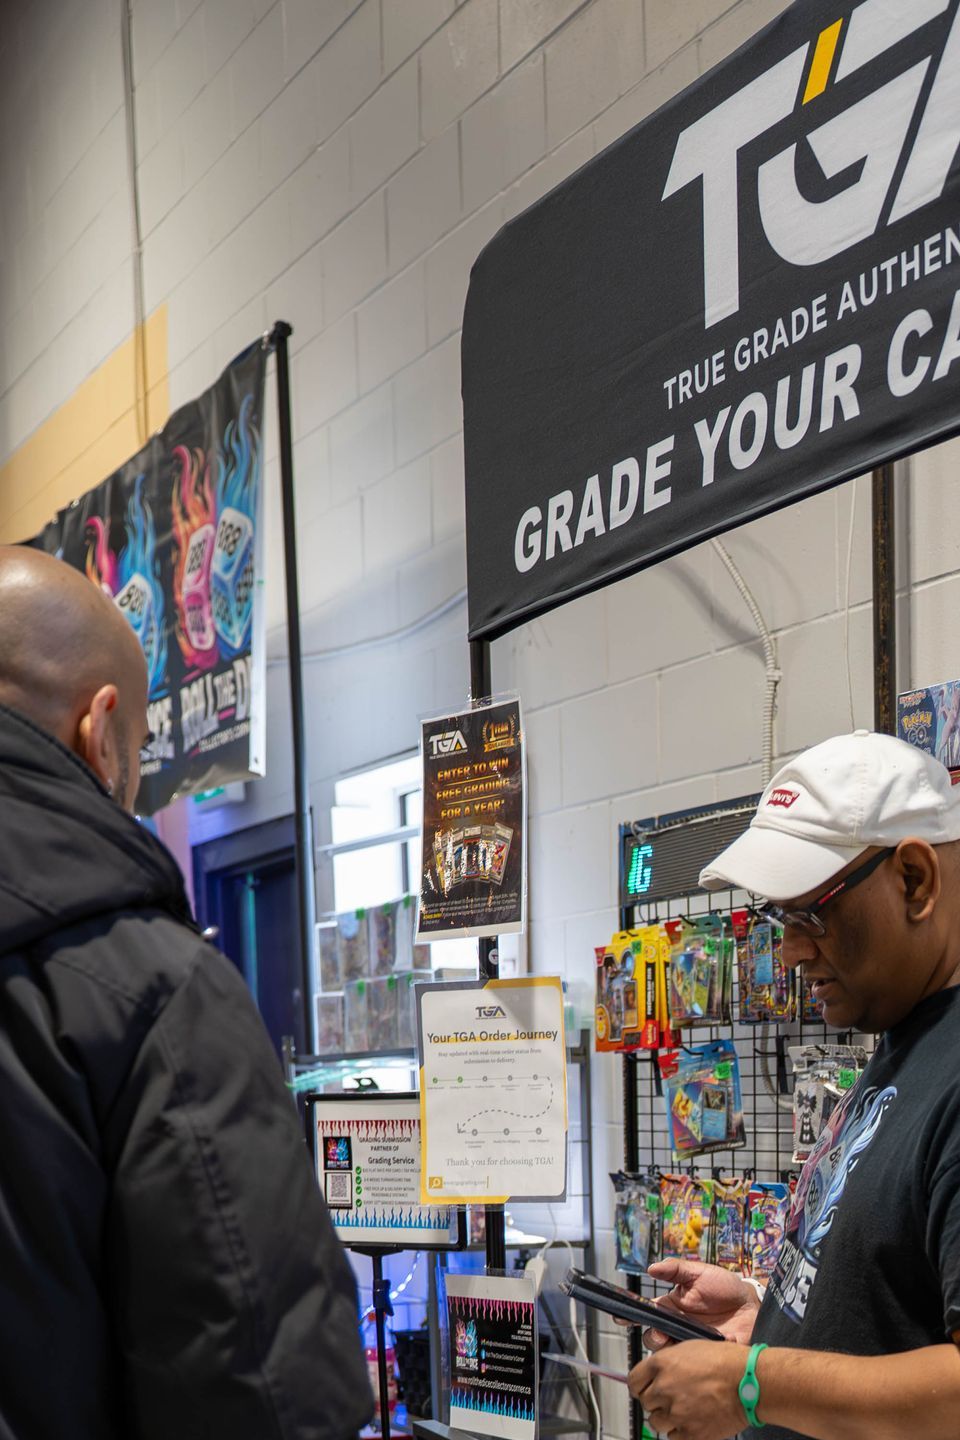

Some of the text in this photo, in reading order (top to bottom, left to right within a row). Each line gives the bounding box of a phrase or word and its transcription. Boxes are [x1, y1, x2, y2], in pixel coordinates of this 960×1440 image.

[663, 362, 727, 410] TRUE
[734, 294, 828, 372] GRADE
[513, 436, 675, 574] GRADE
[694, 343, 862, 488] YOUR
[428, 729, 468, 755] TGA
[437, 757, 509, 782] ENTER TO WIN
[436, 777, 510, 801] FREE GRADING
[441, 806, 461, 820] FOR
[464, 805, 471, 816] A
[475, 1005, 507, 1018] TGA
[427, 1028, 558, 1044] Your TGA Order Journey
[359, 1136, 381, 1144] GRADING
[368, 1156, 415, 1165] Grading Service
[446, 1156, 554, 1168] Thank you for choosing TGA!
